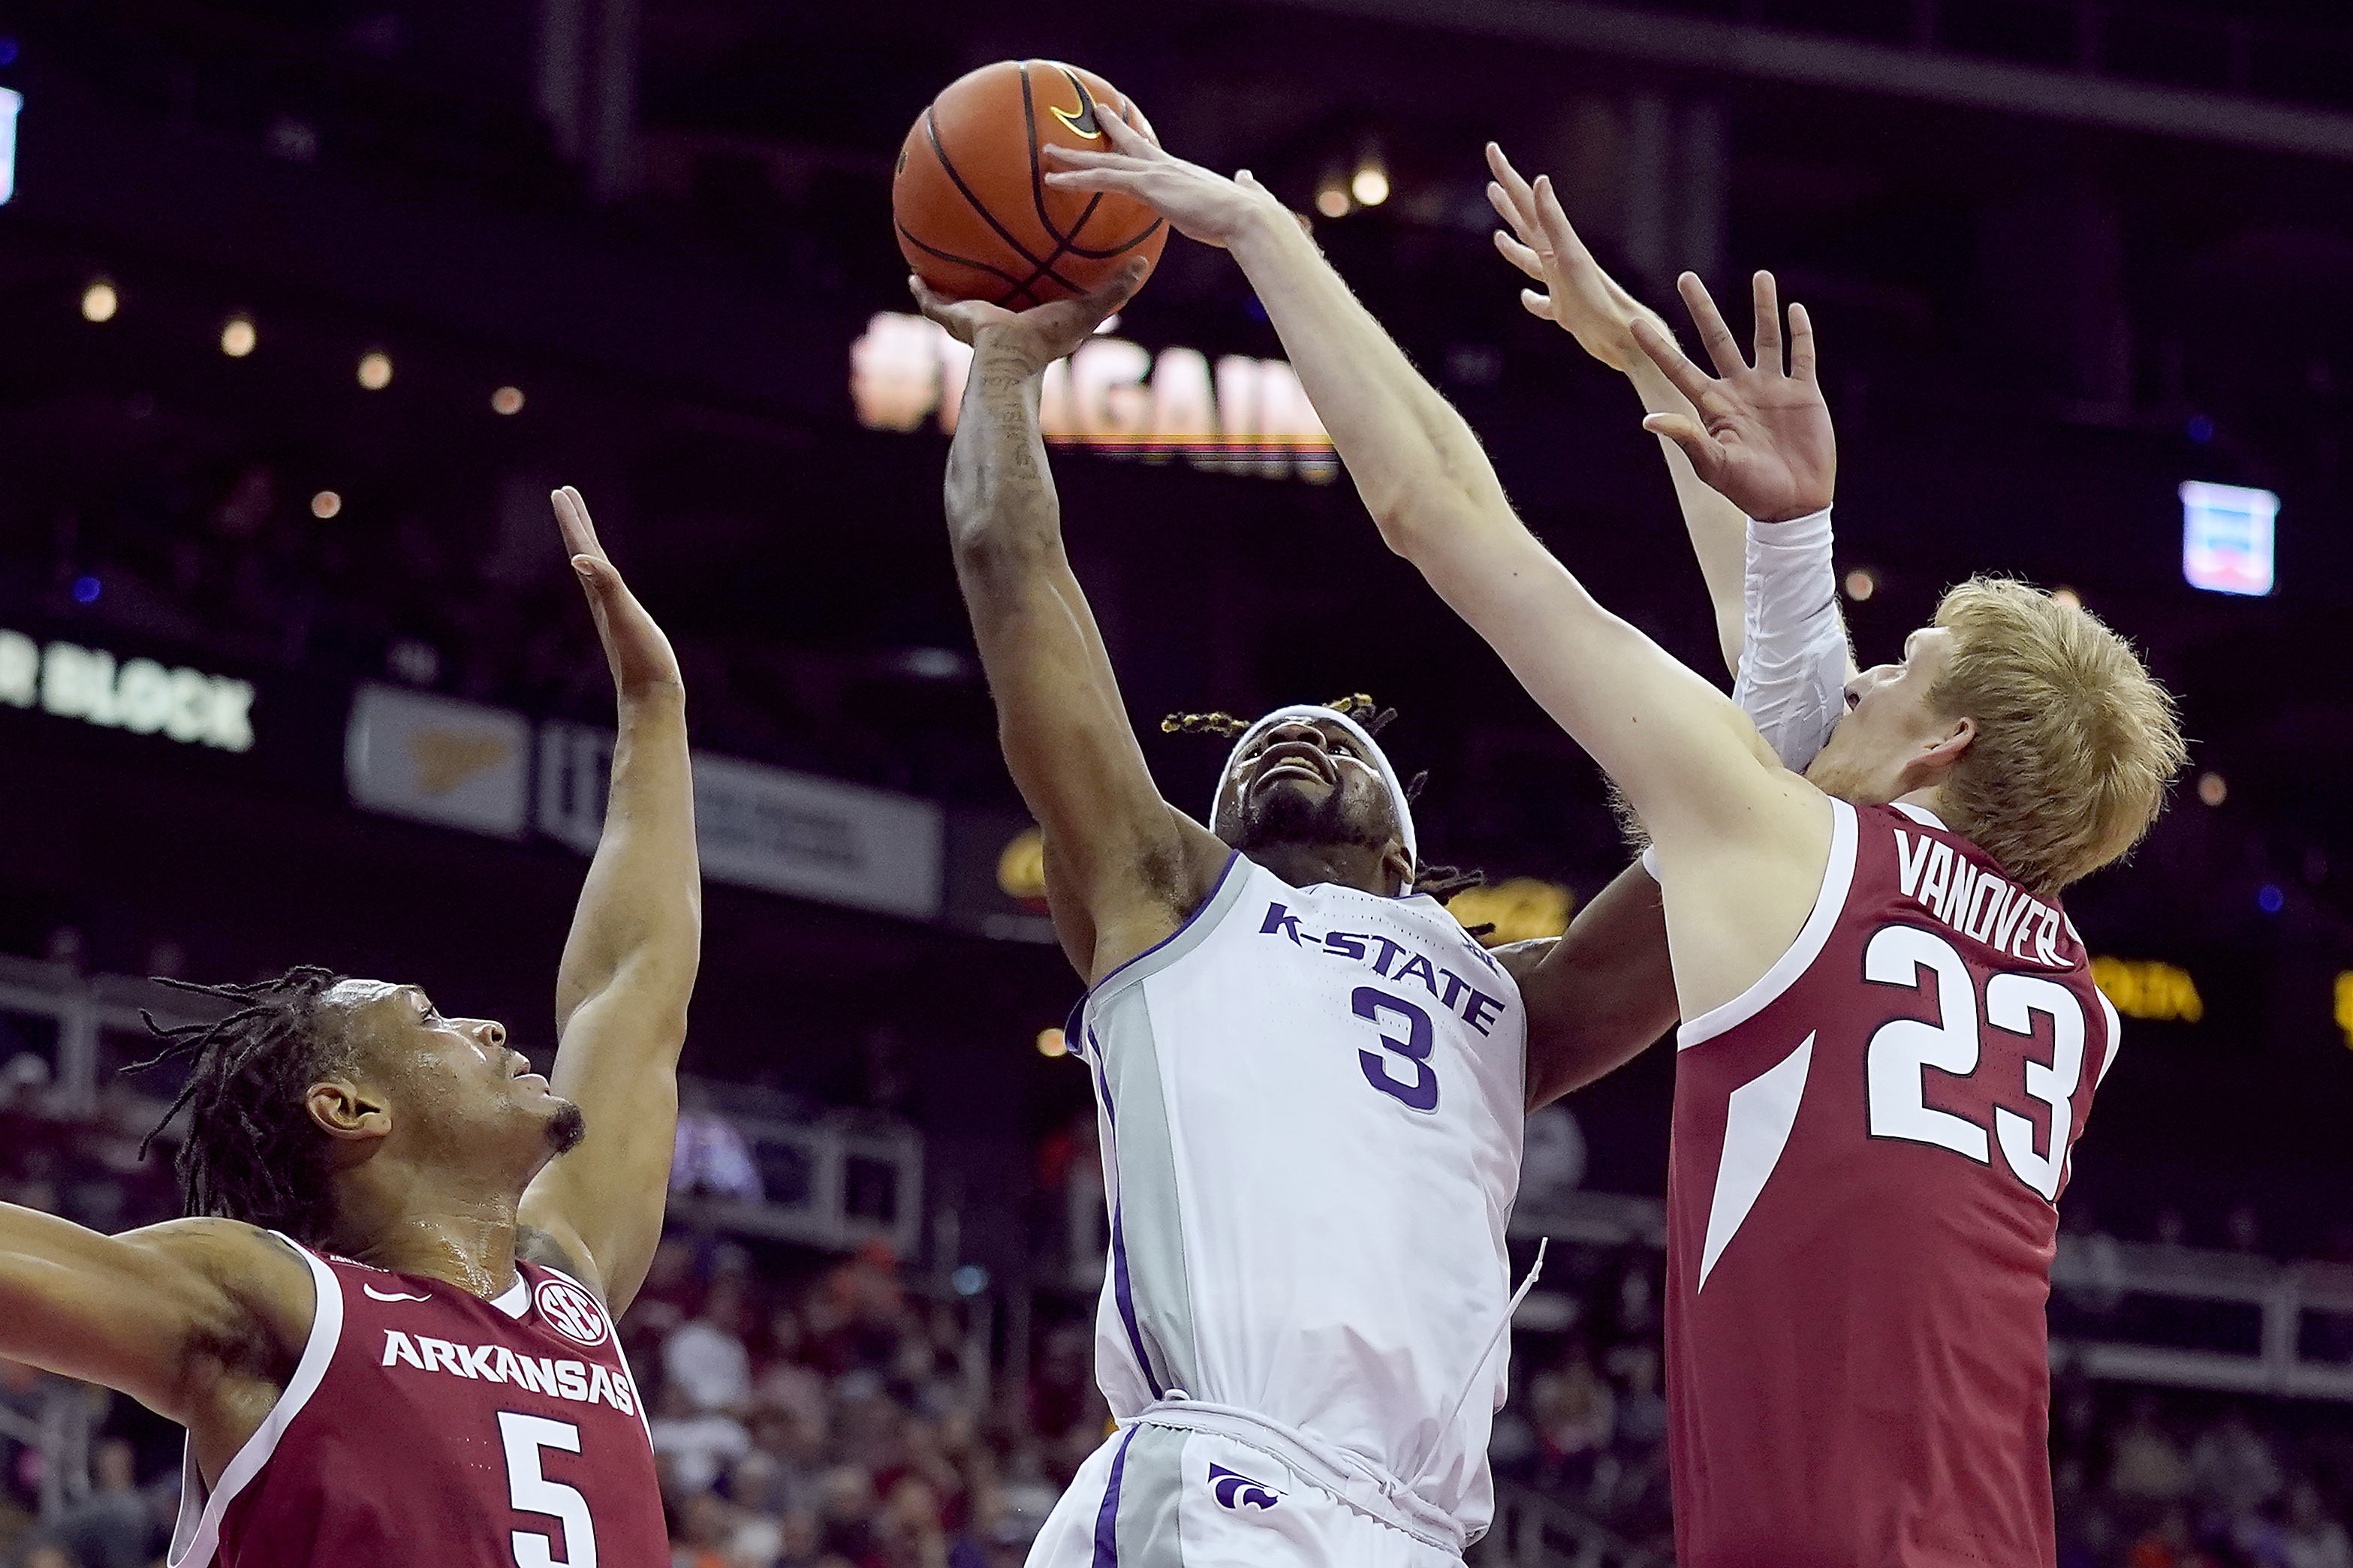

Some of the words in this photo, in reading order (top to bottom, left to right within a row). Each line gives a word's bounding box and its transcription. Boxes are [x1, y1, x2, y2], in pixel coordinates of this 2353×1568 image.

[42, 640, 255, 753] BLOCK
[1894, 829, 2074, 967] VANOVER
[1259, 901, 1505, 1037] K-STATE
[1352, 986, 1439, 1115] 3
[1865, 924, 2086, 1201] 23
[382, 1329, 636, 1416] ARKANSAS
[538, 1284, 604, 1340] SEC
[496, 1410, 598, 1568] 5
